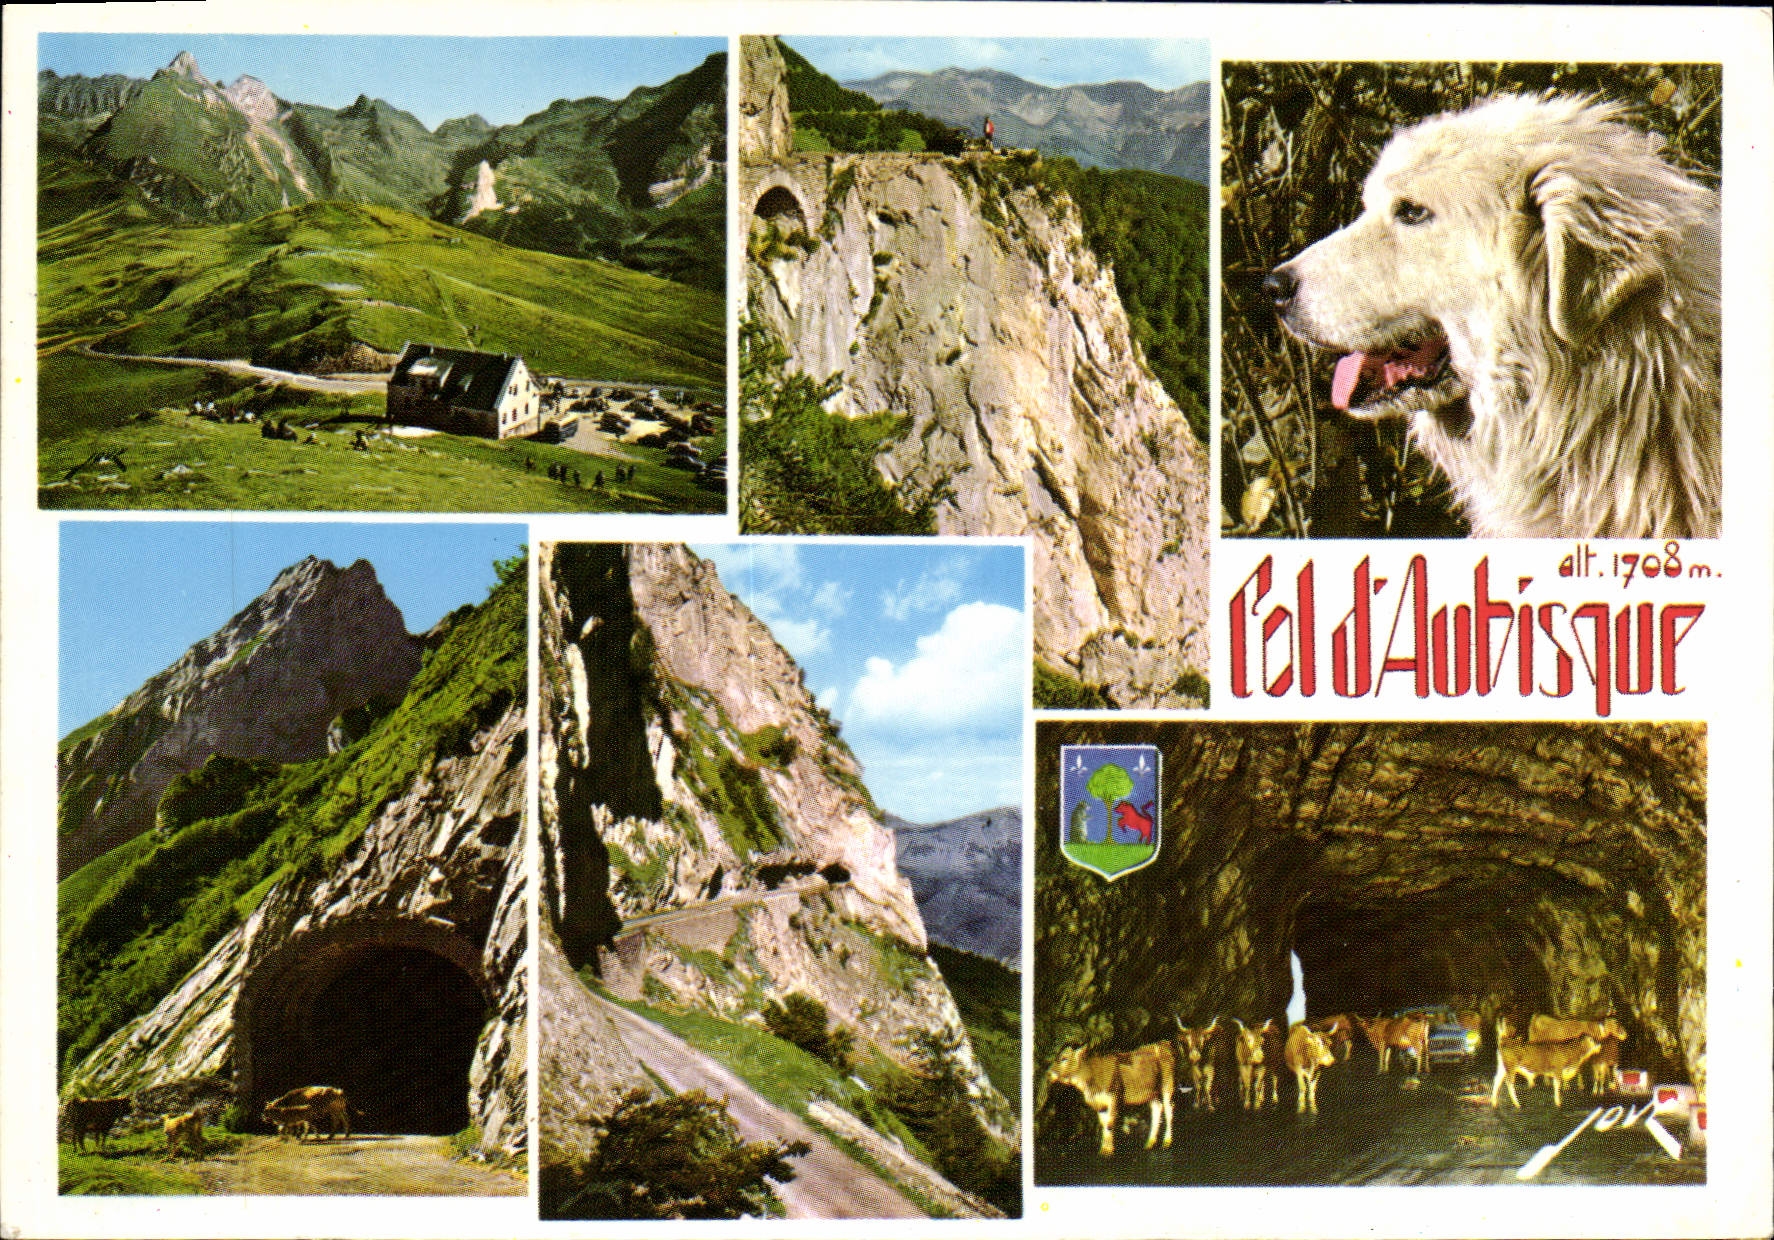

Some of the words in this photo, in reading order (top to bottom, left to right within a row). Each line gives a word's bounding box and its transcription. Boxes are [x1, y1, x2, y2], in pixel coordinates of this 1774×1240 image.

[1558, 543, 1604, 577] alt.
[1613, 540, 1683, 590] 1708
[1688, 563, 1723, 578] m.
[1229, 554, 1317, 699] Col
[1331, 554, 1707, 718] d'Aubisque
